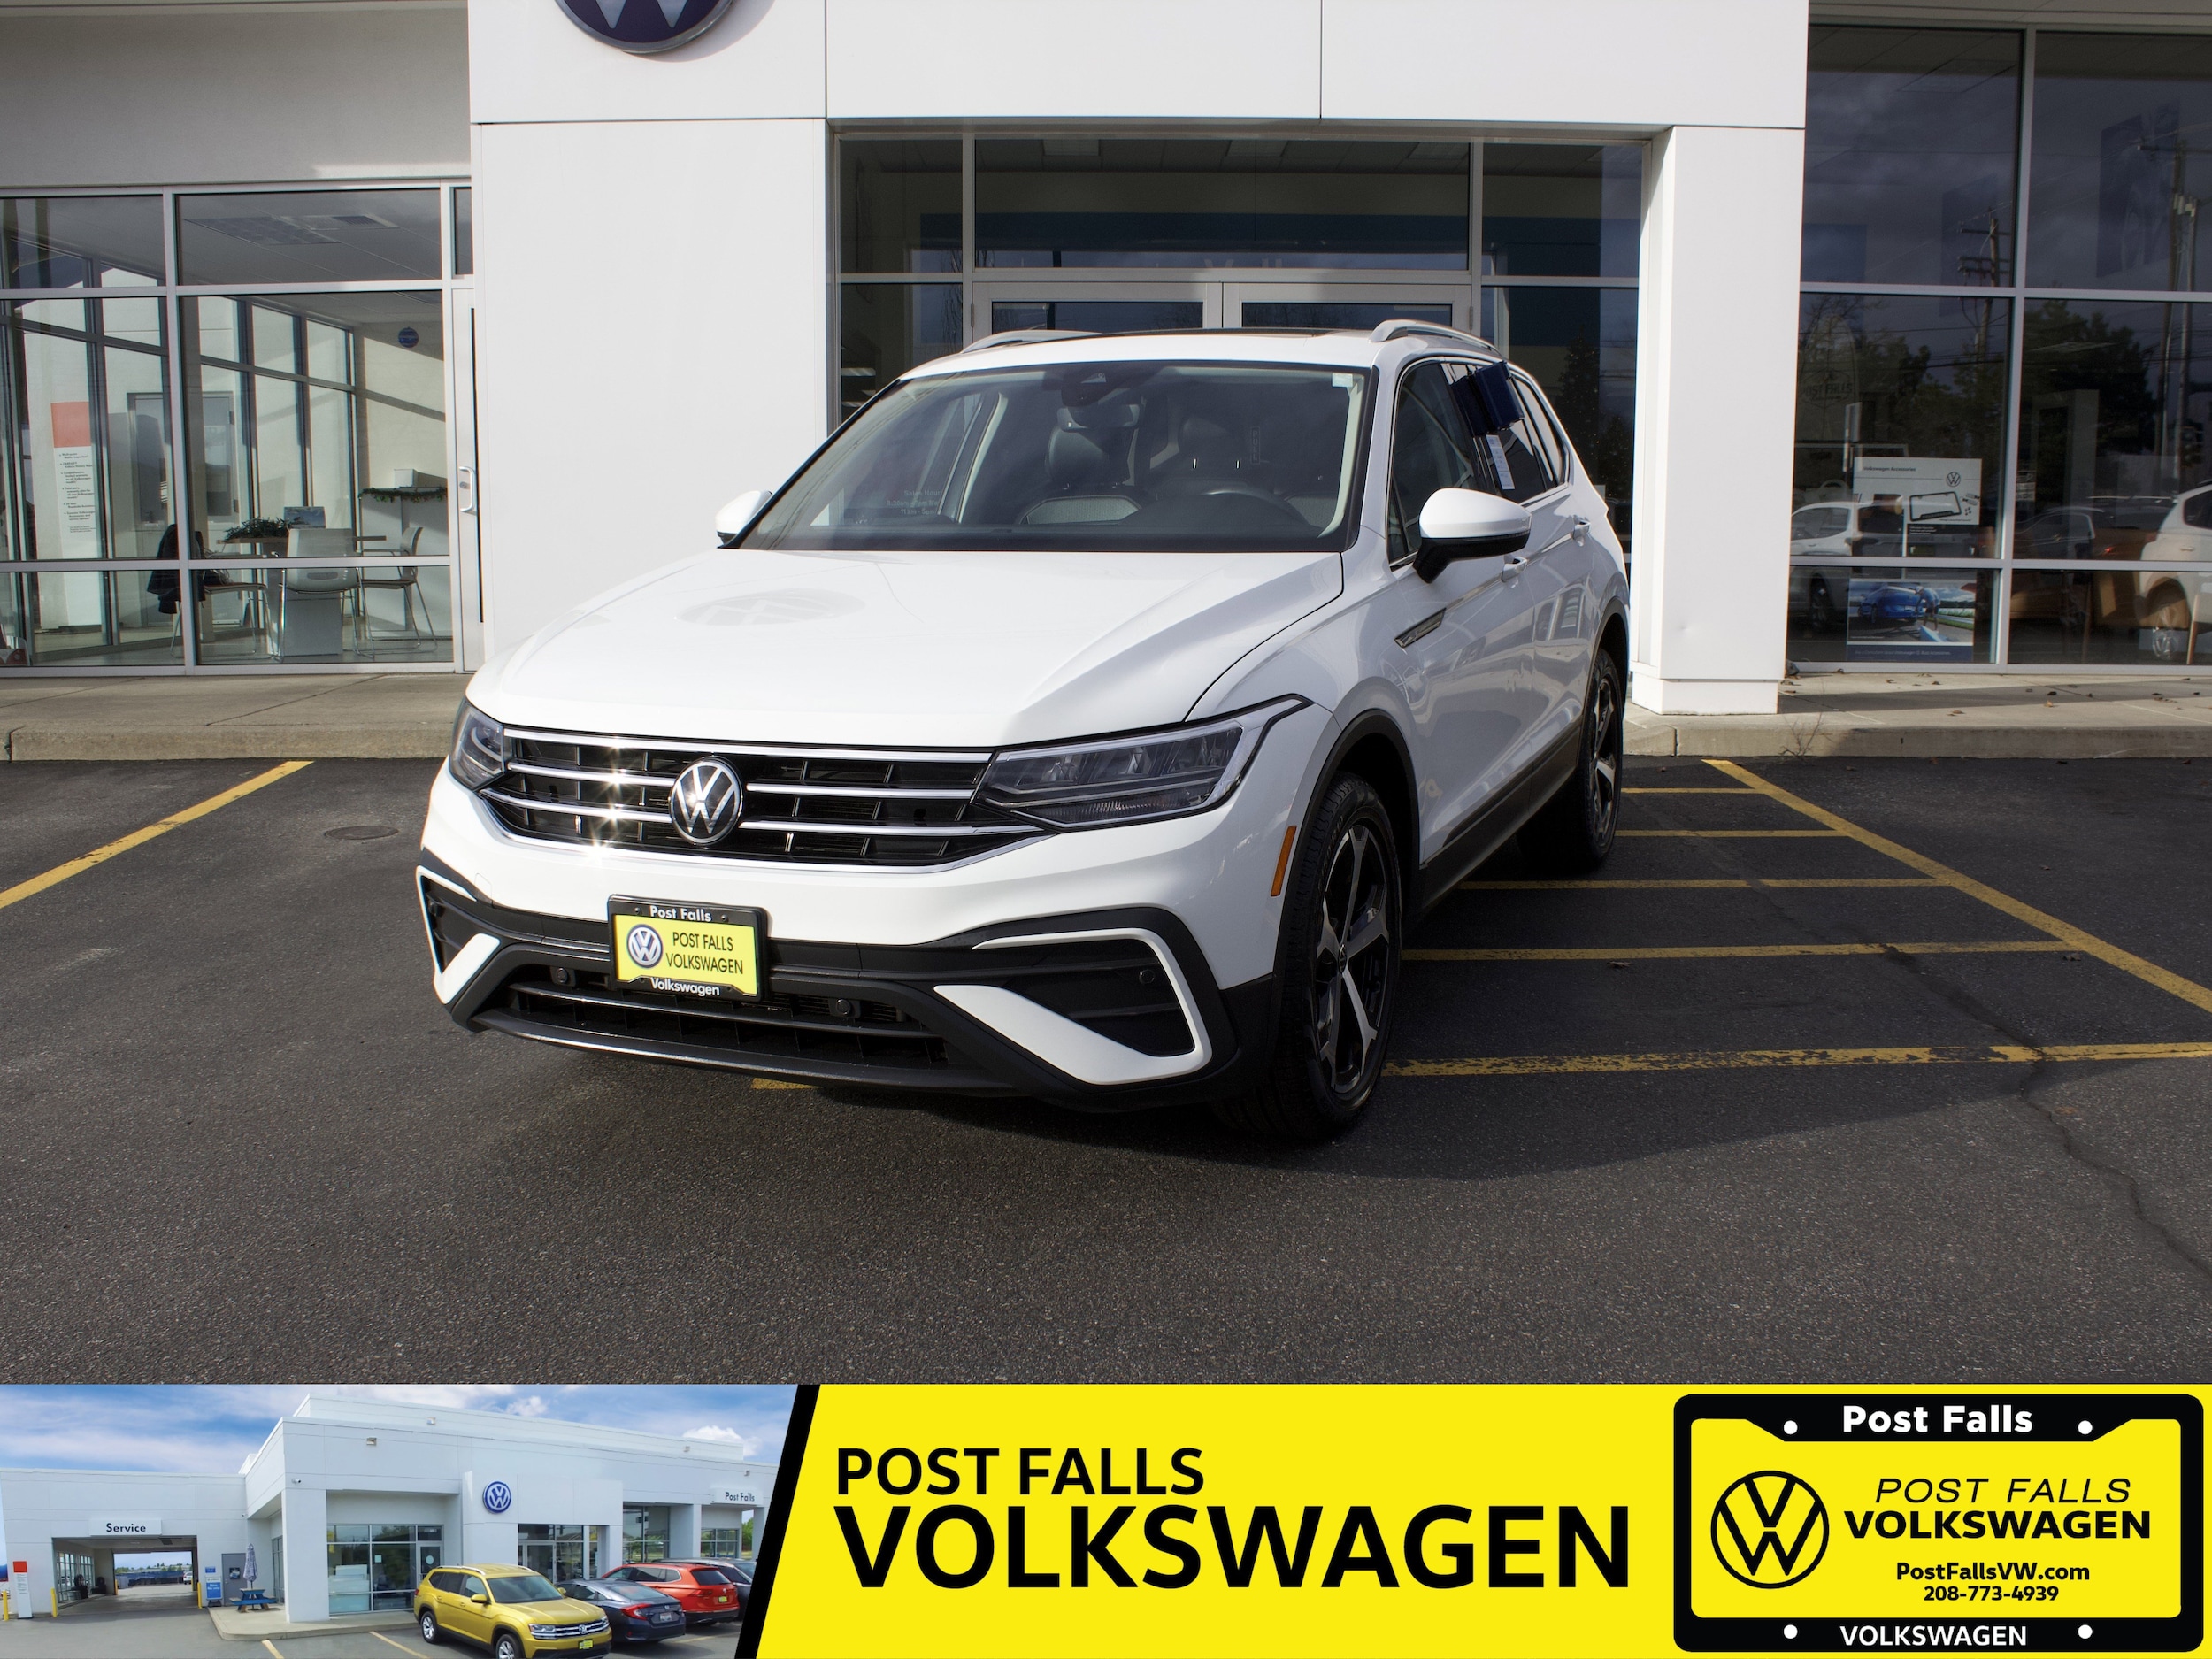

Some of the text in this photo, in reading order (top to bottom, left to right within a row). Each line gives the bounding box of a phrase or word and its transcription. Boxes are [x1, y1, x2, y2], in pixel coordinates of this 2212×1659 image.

[649, 905, 712, 923] Post Falls
[672, 932, 733, 951] POST FALLS
[665, 953, 744, 975] VOLKSWAGEN
[650, 977, 720, 996] Volkswagen
